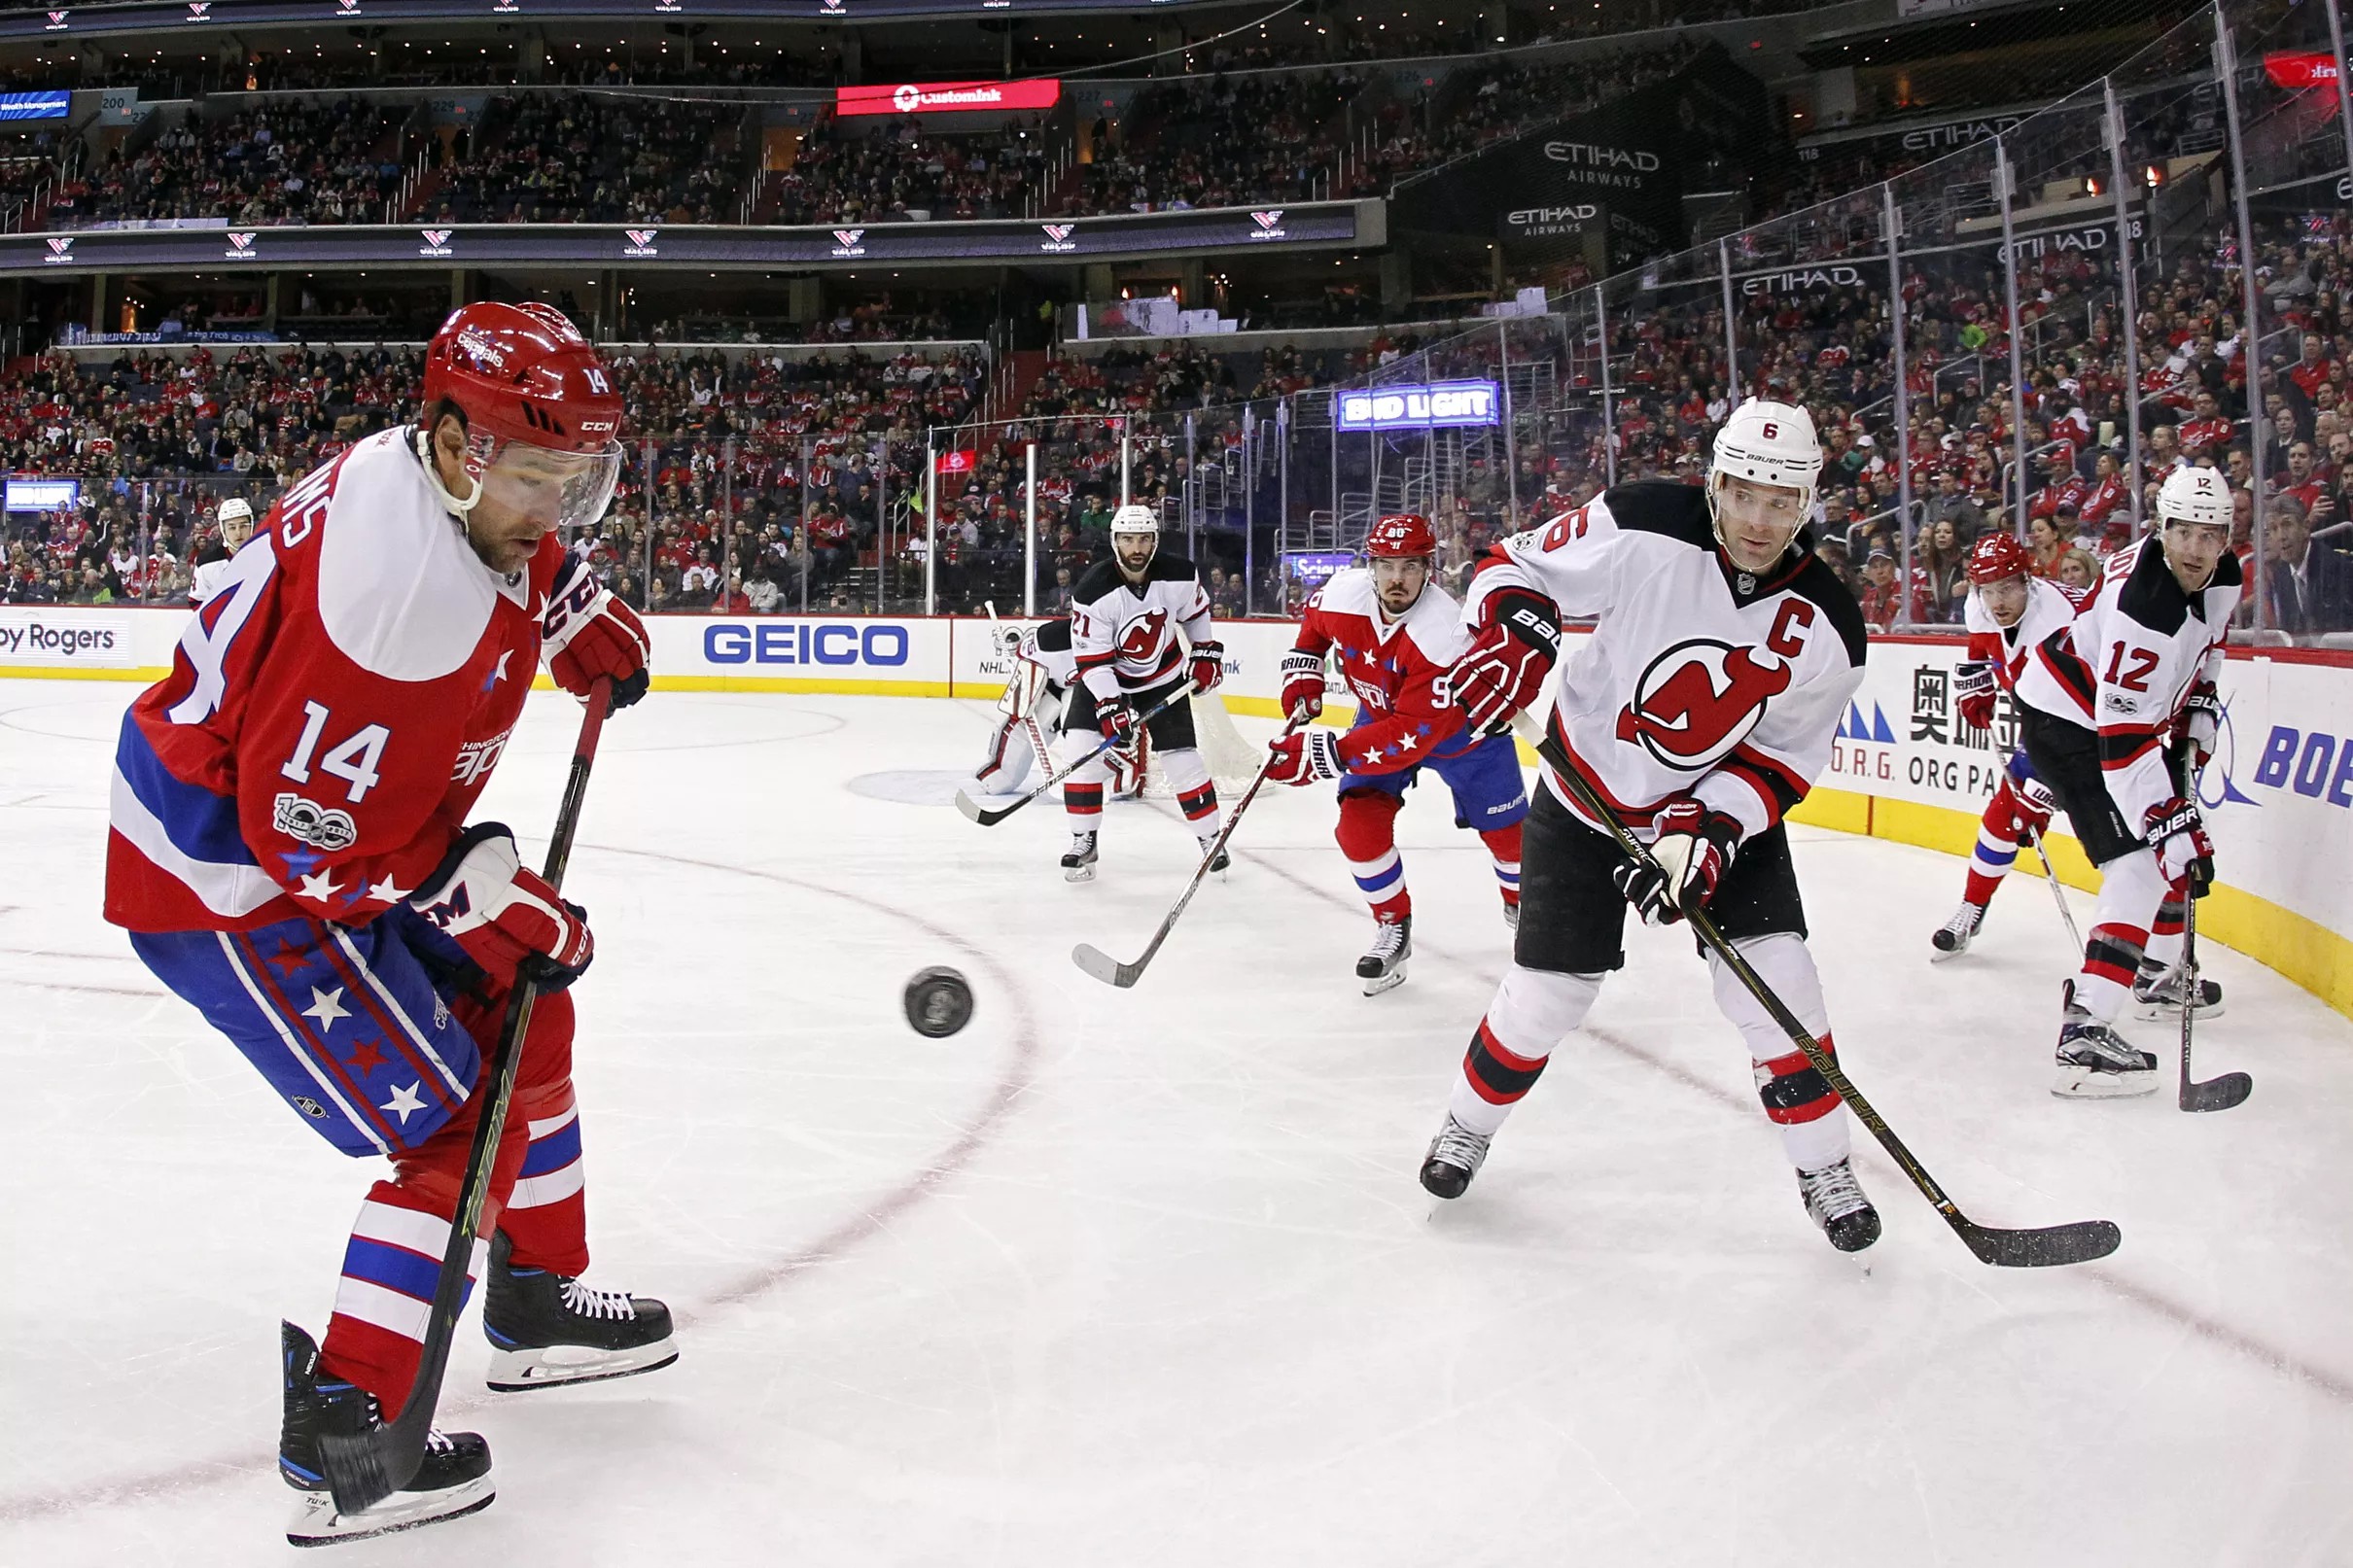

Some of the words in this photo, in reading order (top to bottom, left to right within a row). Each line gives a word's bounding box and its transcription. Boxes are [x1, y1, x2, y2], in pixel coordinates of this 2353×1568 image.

[23, 100, 67, 110] Management
[102, 97, 124, 108] 200
[1902, 117, 2020, 151] ETIHAD
[1544, 141, 1660, 172] ETIHAD
[1567, 169, 1642, 190] AIRWAYS
[1508, 204, 1597, 225] ETIHAD
[1524, 223, 1581, 236] AIRWAYS
[1742, 266, 1858, 296] ETIHAD
[582, 367, 610, 394] 14
[1345, 396, 1404, 422] BUD
[1407, 390, 1490, 419] LIGHT
[580, 421, 615, 433] CCM
[1762, 423, 1778, 440] 6
[1746, 452, 1785, 467] BAUER
[2197, 477, 2212, 489] 12
[542, 570, 602, 641] CC
[1071, 610, 1091, 639] 21
[1767, 596, 1815, 659] C
[29, 623, 115, 656] Rogers
[703, 624, 909, 666] GEICO
[978, 661, 1012, 675] NHL.
[2104, 639, 2160, 693] 12
[282, 700, 391, 803] 14
[1909, 755, 1959, 792] ORG
[1967, 764, 1997, 798] PA
[274, 793, 356, 851] 100
[304, 1350, 318, 1376] NEXUS
